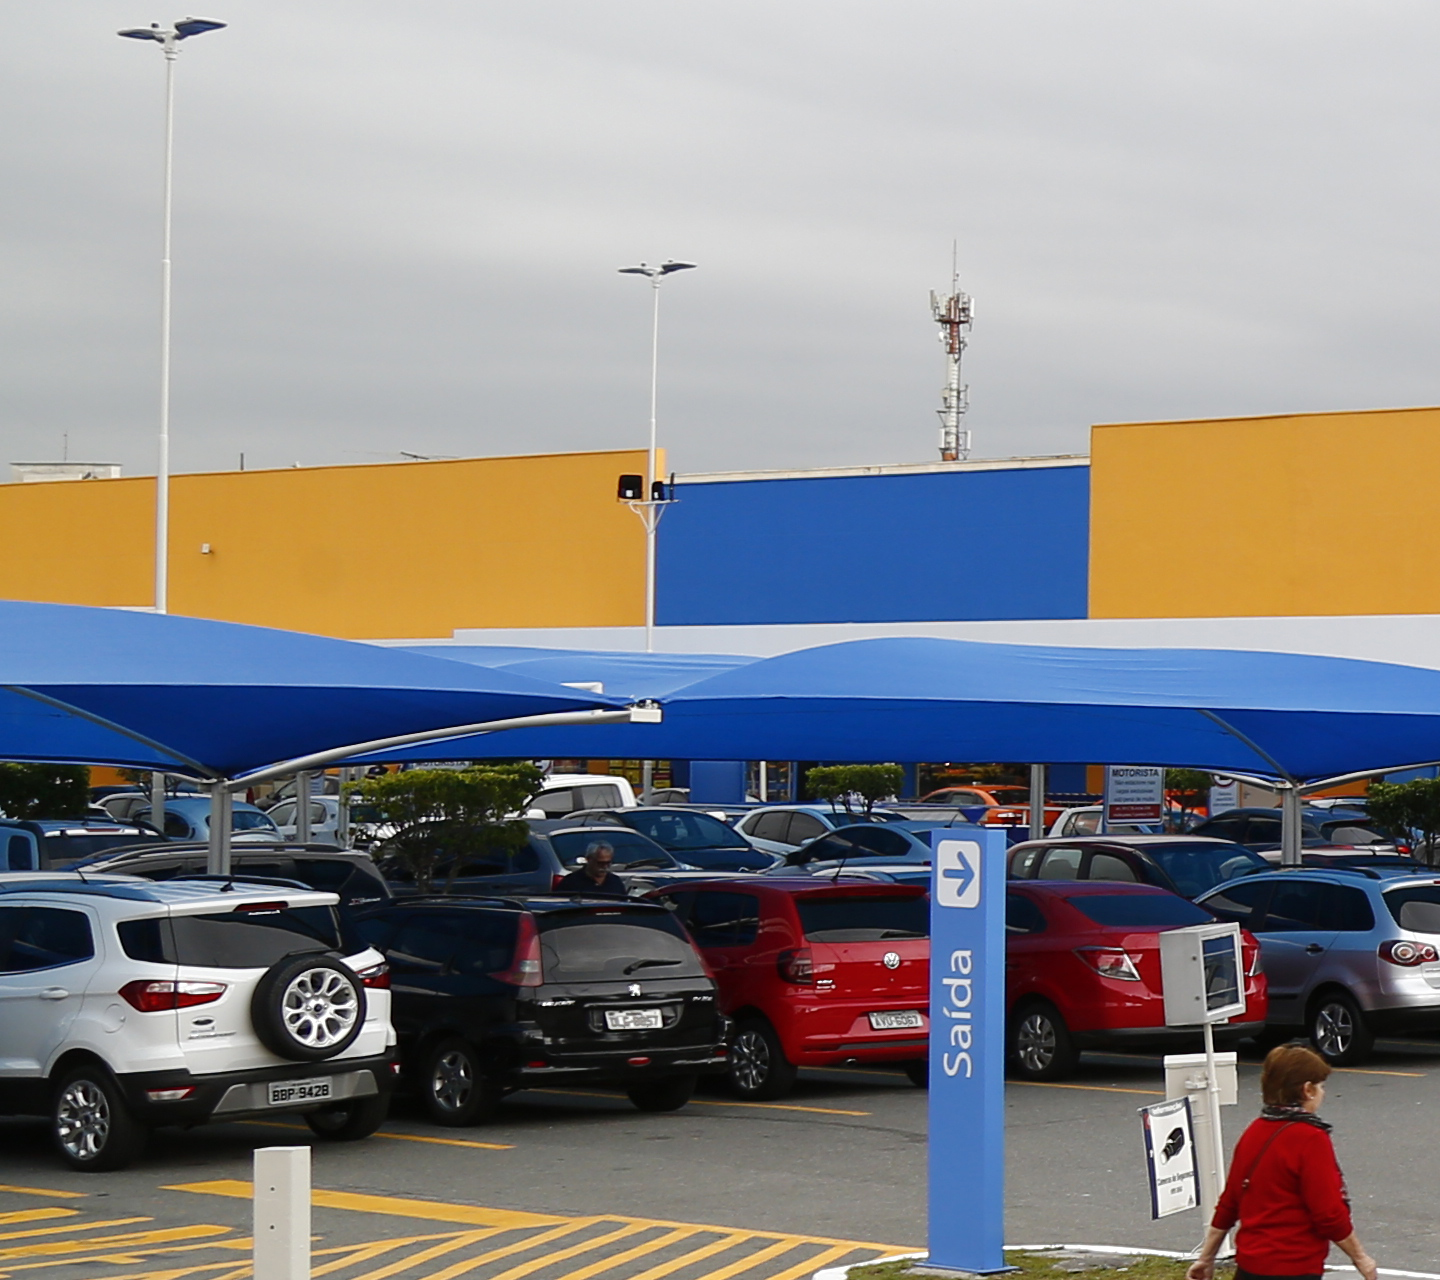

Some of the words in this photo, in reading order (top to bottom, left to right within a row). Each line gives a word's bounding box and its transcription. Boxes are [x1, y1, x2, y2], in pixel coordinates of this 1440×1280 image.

[1111, 768, 1160, 777] MOTORISTA
[942, 949, 972, 1078] Saída
[272, 1084, 330, 1102] BBP-9428
